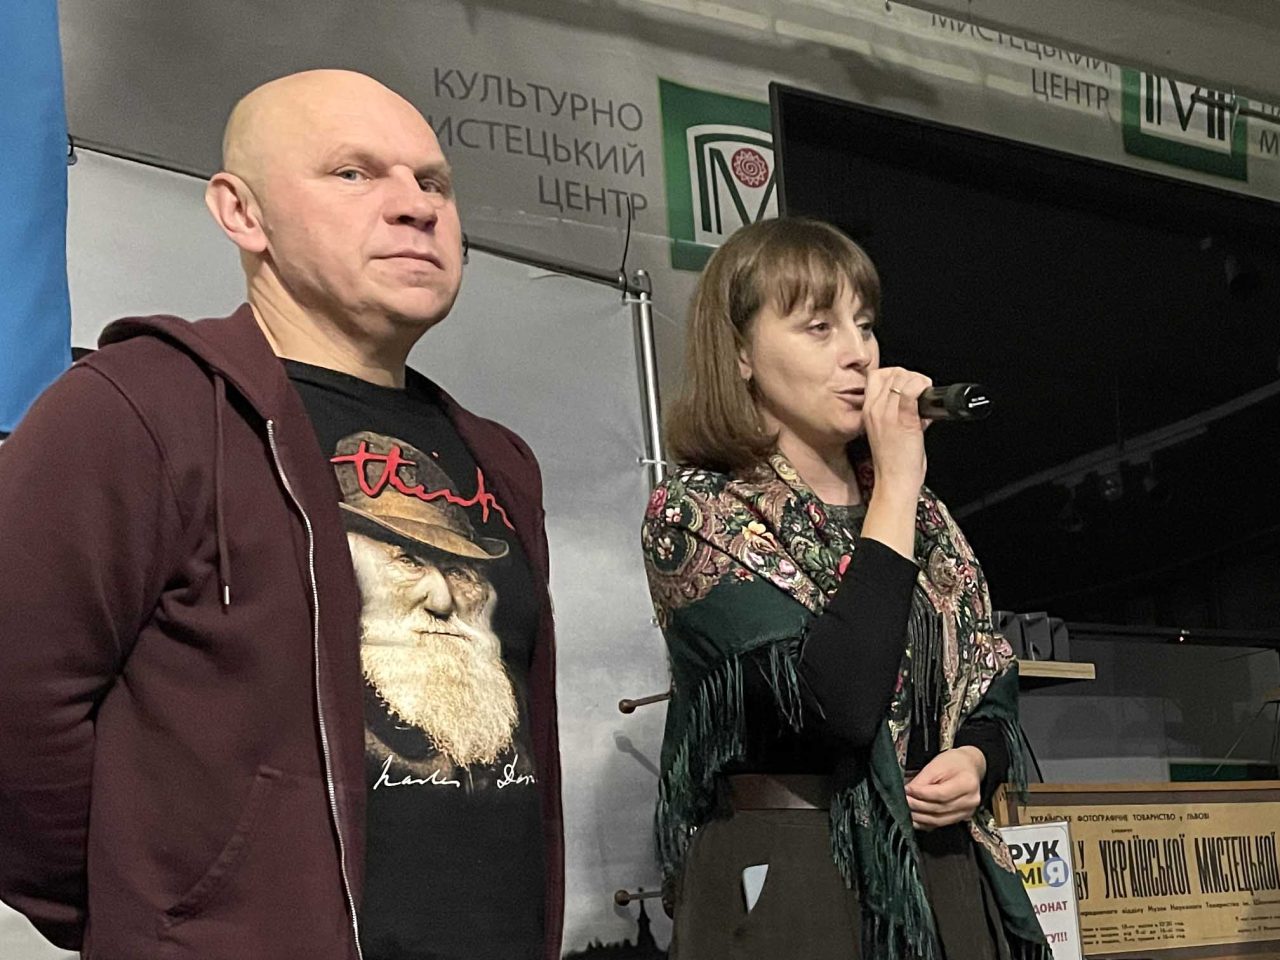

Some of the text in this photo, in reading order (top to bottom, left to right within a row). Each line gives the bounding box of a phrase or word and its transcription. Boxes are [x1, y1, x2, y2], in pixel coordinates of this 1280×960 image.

[433, 67, 643, 132] КУЛЬТУРНО
[1031, 68, 1110, 110] ЦЕНТР
[430, 114, 645, 178] ИСТЕЦЬКИЙ
[538, 175, 648, 221] ЦЕНТР
[1098, 833, 1192, 900] УКРАЇНСЬКОЇ
[1194, 831, 1280, 896] МИСТЕЦЬКОЇ
